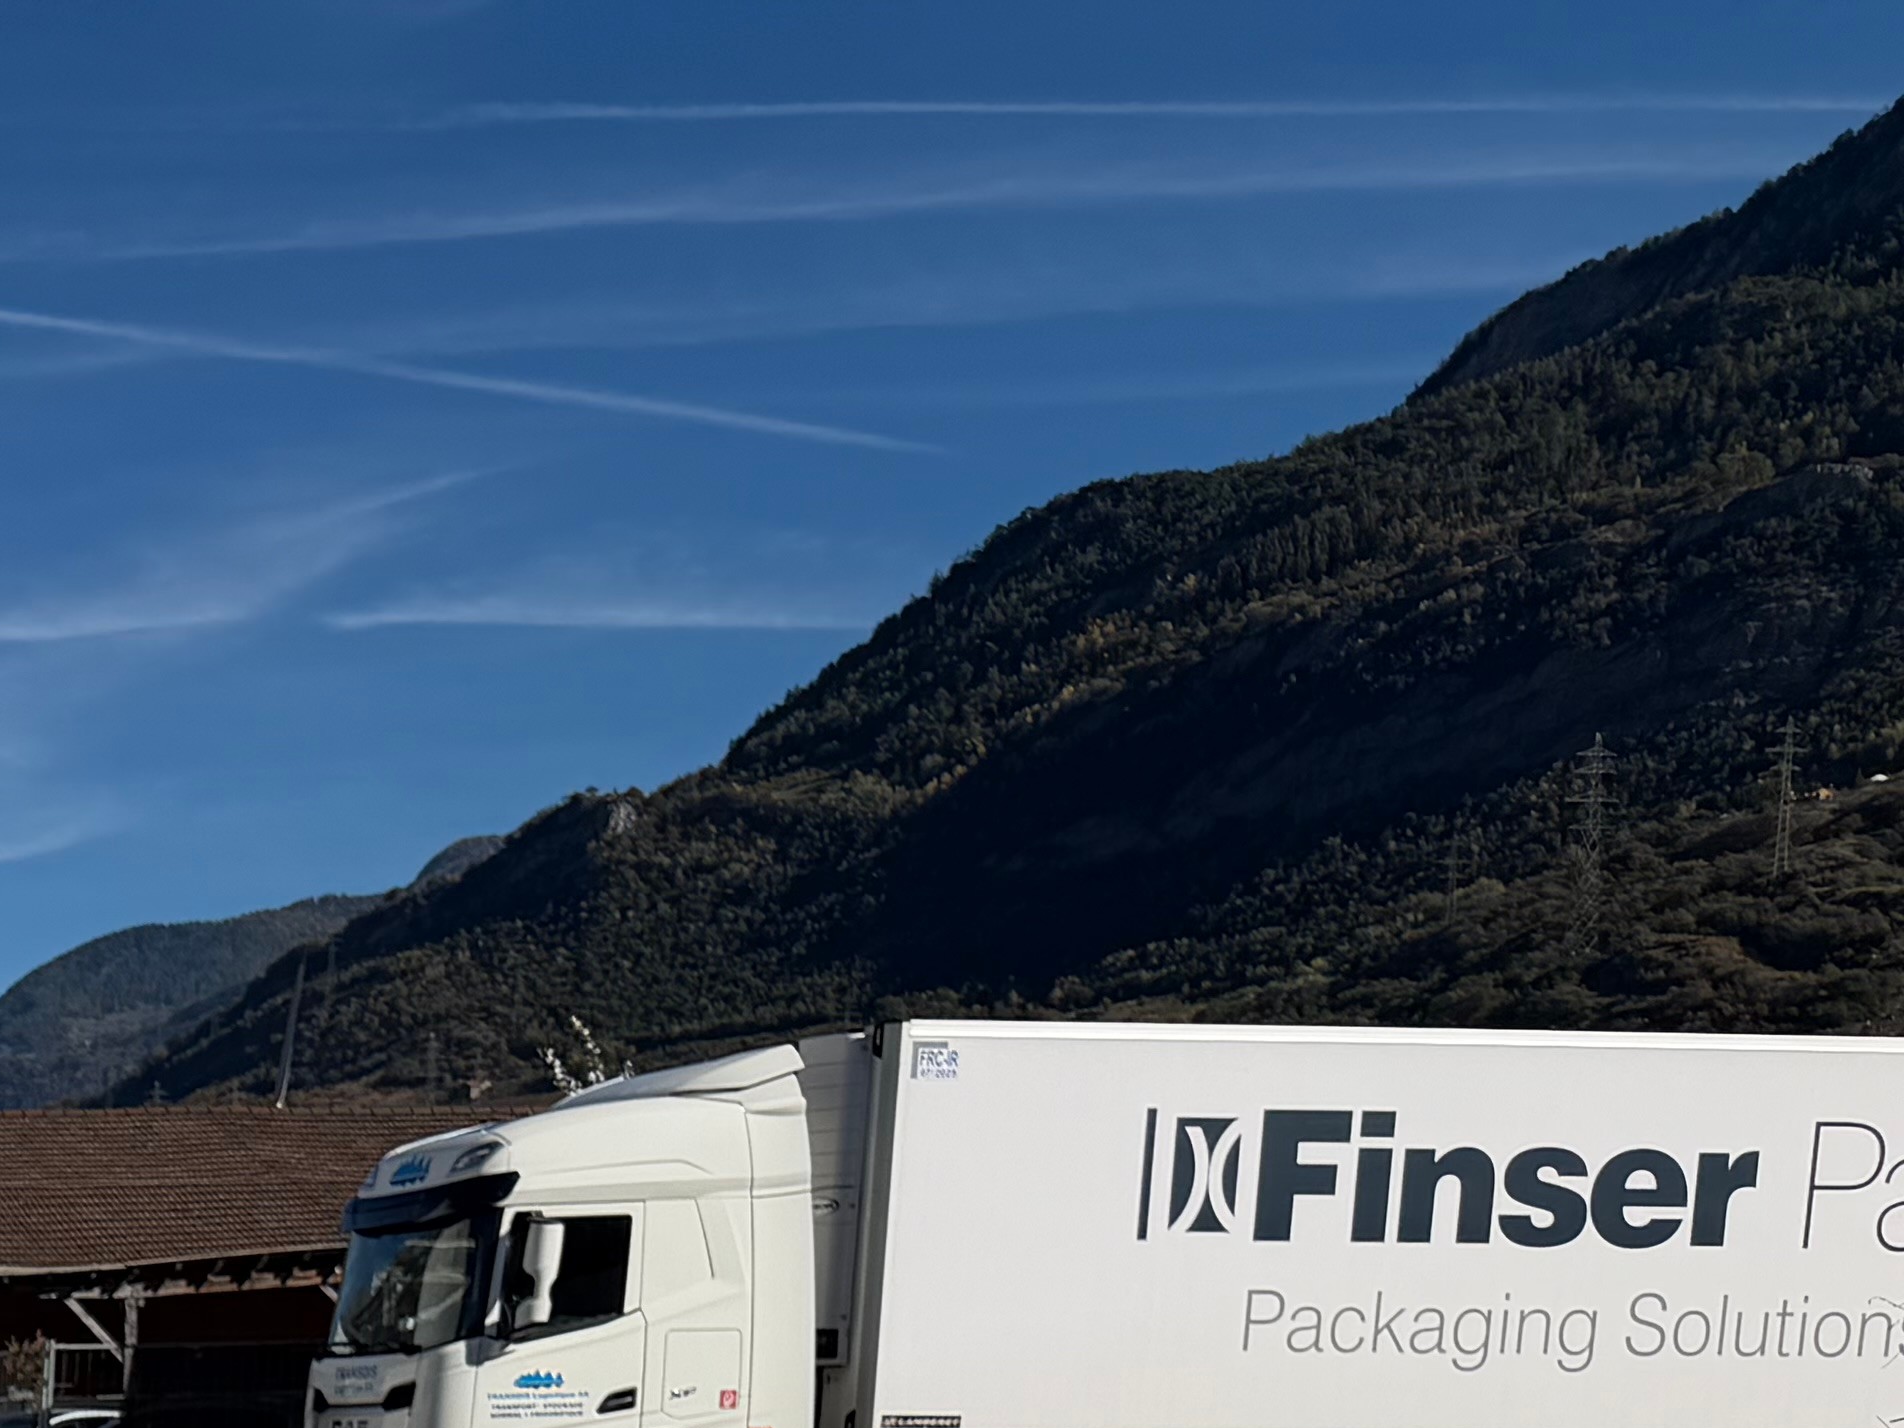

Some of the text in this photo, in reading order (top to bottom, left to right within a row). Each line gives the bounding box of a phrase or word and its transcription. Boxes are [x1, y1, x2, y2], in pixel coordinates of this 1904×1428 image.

[1252, 1109, 1760, 1249] Finser
[1242, 1290, 1904, 1373] Packaging Solution
